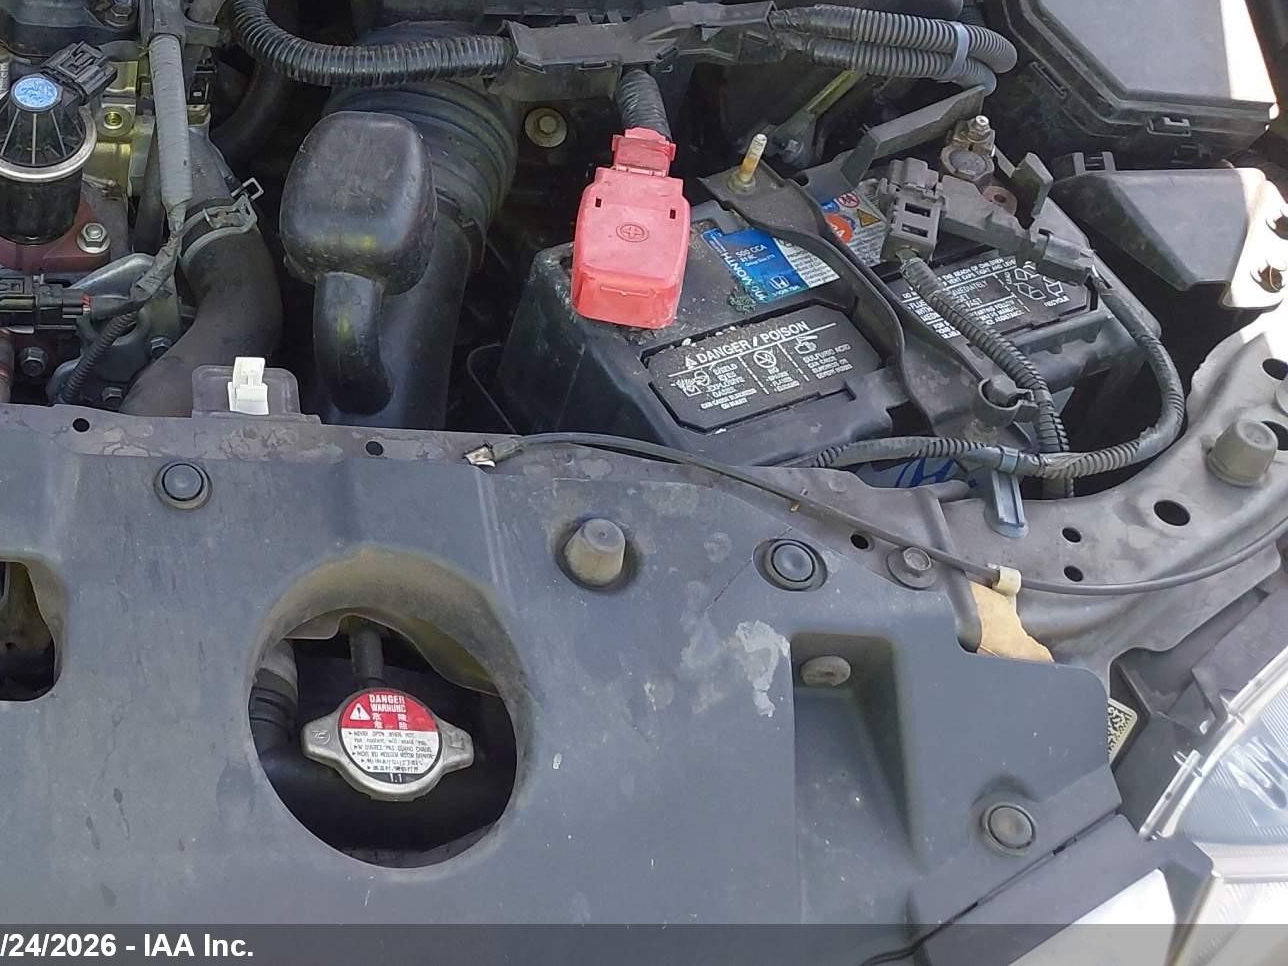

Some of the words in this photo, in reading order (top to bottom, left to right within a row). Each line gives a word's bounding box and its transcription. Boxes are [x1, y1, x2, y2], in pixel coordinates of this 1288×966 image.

[721, 251, 753, 286] MONTH
[696, 340, 752, 364] DANGER
[759, 320, 810, 344] POISON
[369, 694, 405, 703] DANGER
[371, 703, 407, 713] WARNING
[389, 773, 402, 783] 1.1
